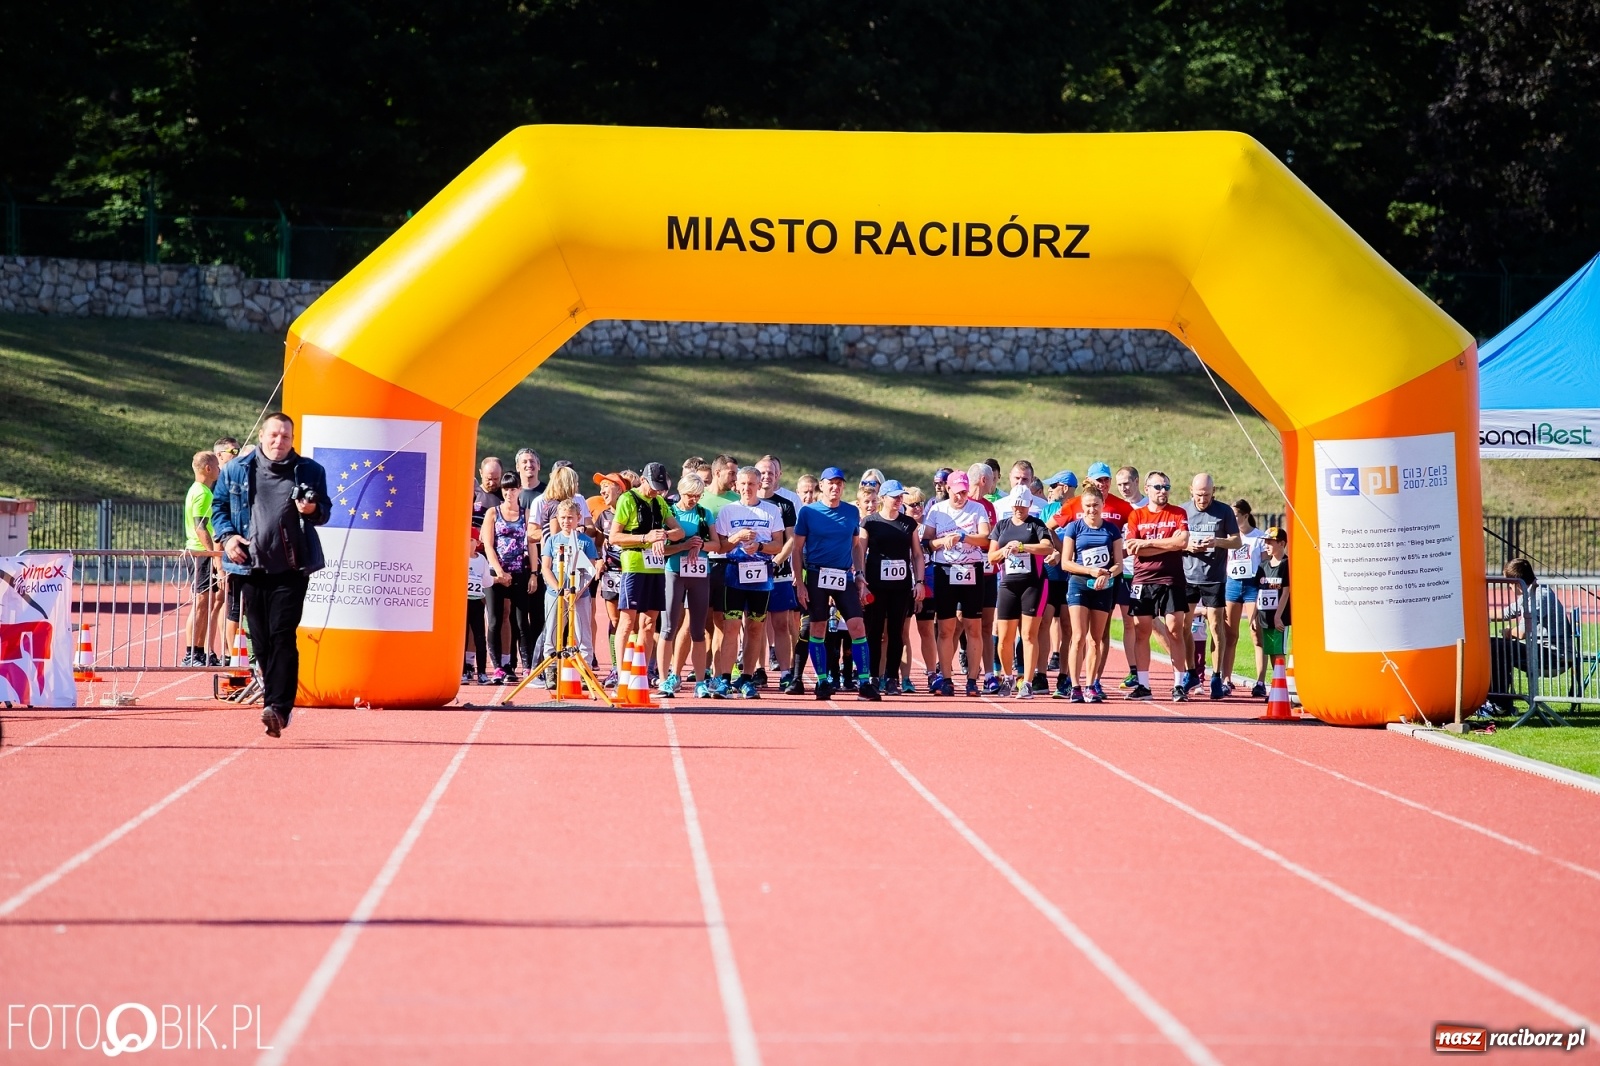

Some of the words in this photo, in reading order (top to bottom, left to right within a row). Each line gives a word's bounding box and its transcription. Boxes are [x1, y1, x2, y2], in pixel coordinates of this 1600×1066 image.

[666, 215, 838, 254] MIASTO
[853, 214, 1090, 259] RACIBÓRZ
[1397, 523, 1440, 533] rejestracyjnym
[1085, 553, 1108, 566] 220
[342, 560, 413, 571] EUROPEJSKA
[682, 564, 706, 573] 139
[1231, 565, 1246, 575] 49
[23, 565, 65, 579] vimex
[309, 570, 370, 582] UROPEJSKI
[373, 573, 423, 583] FUNDUSZ
[745, 569, 762, 579] 67
[882, 566, 906, 577] 100
[955, 572, 971, 581] 64
[1343, 570, 1387, 578] Europejskiego
[821, 575, 845, 587] 178
[21, 582, 63, 594] reklama
[348, 584, 431, 596] REGIONALNEGO
[383, 597, 429, 608] GRANICE
